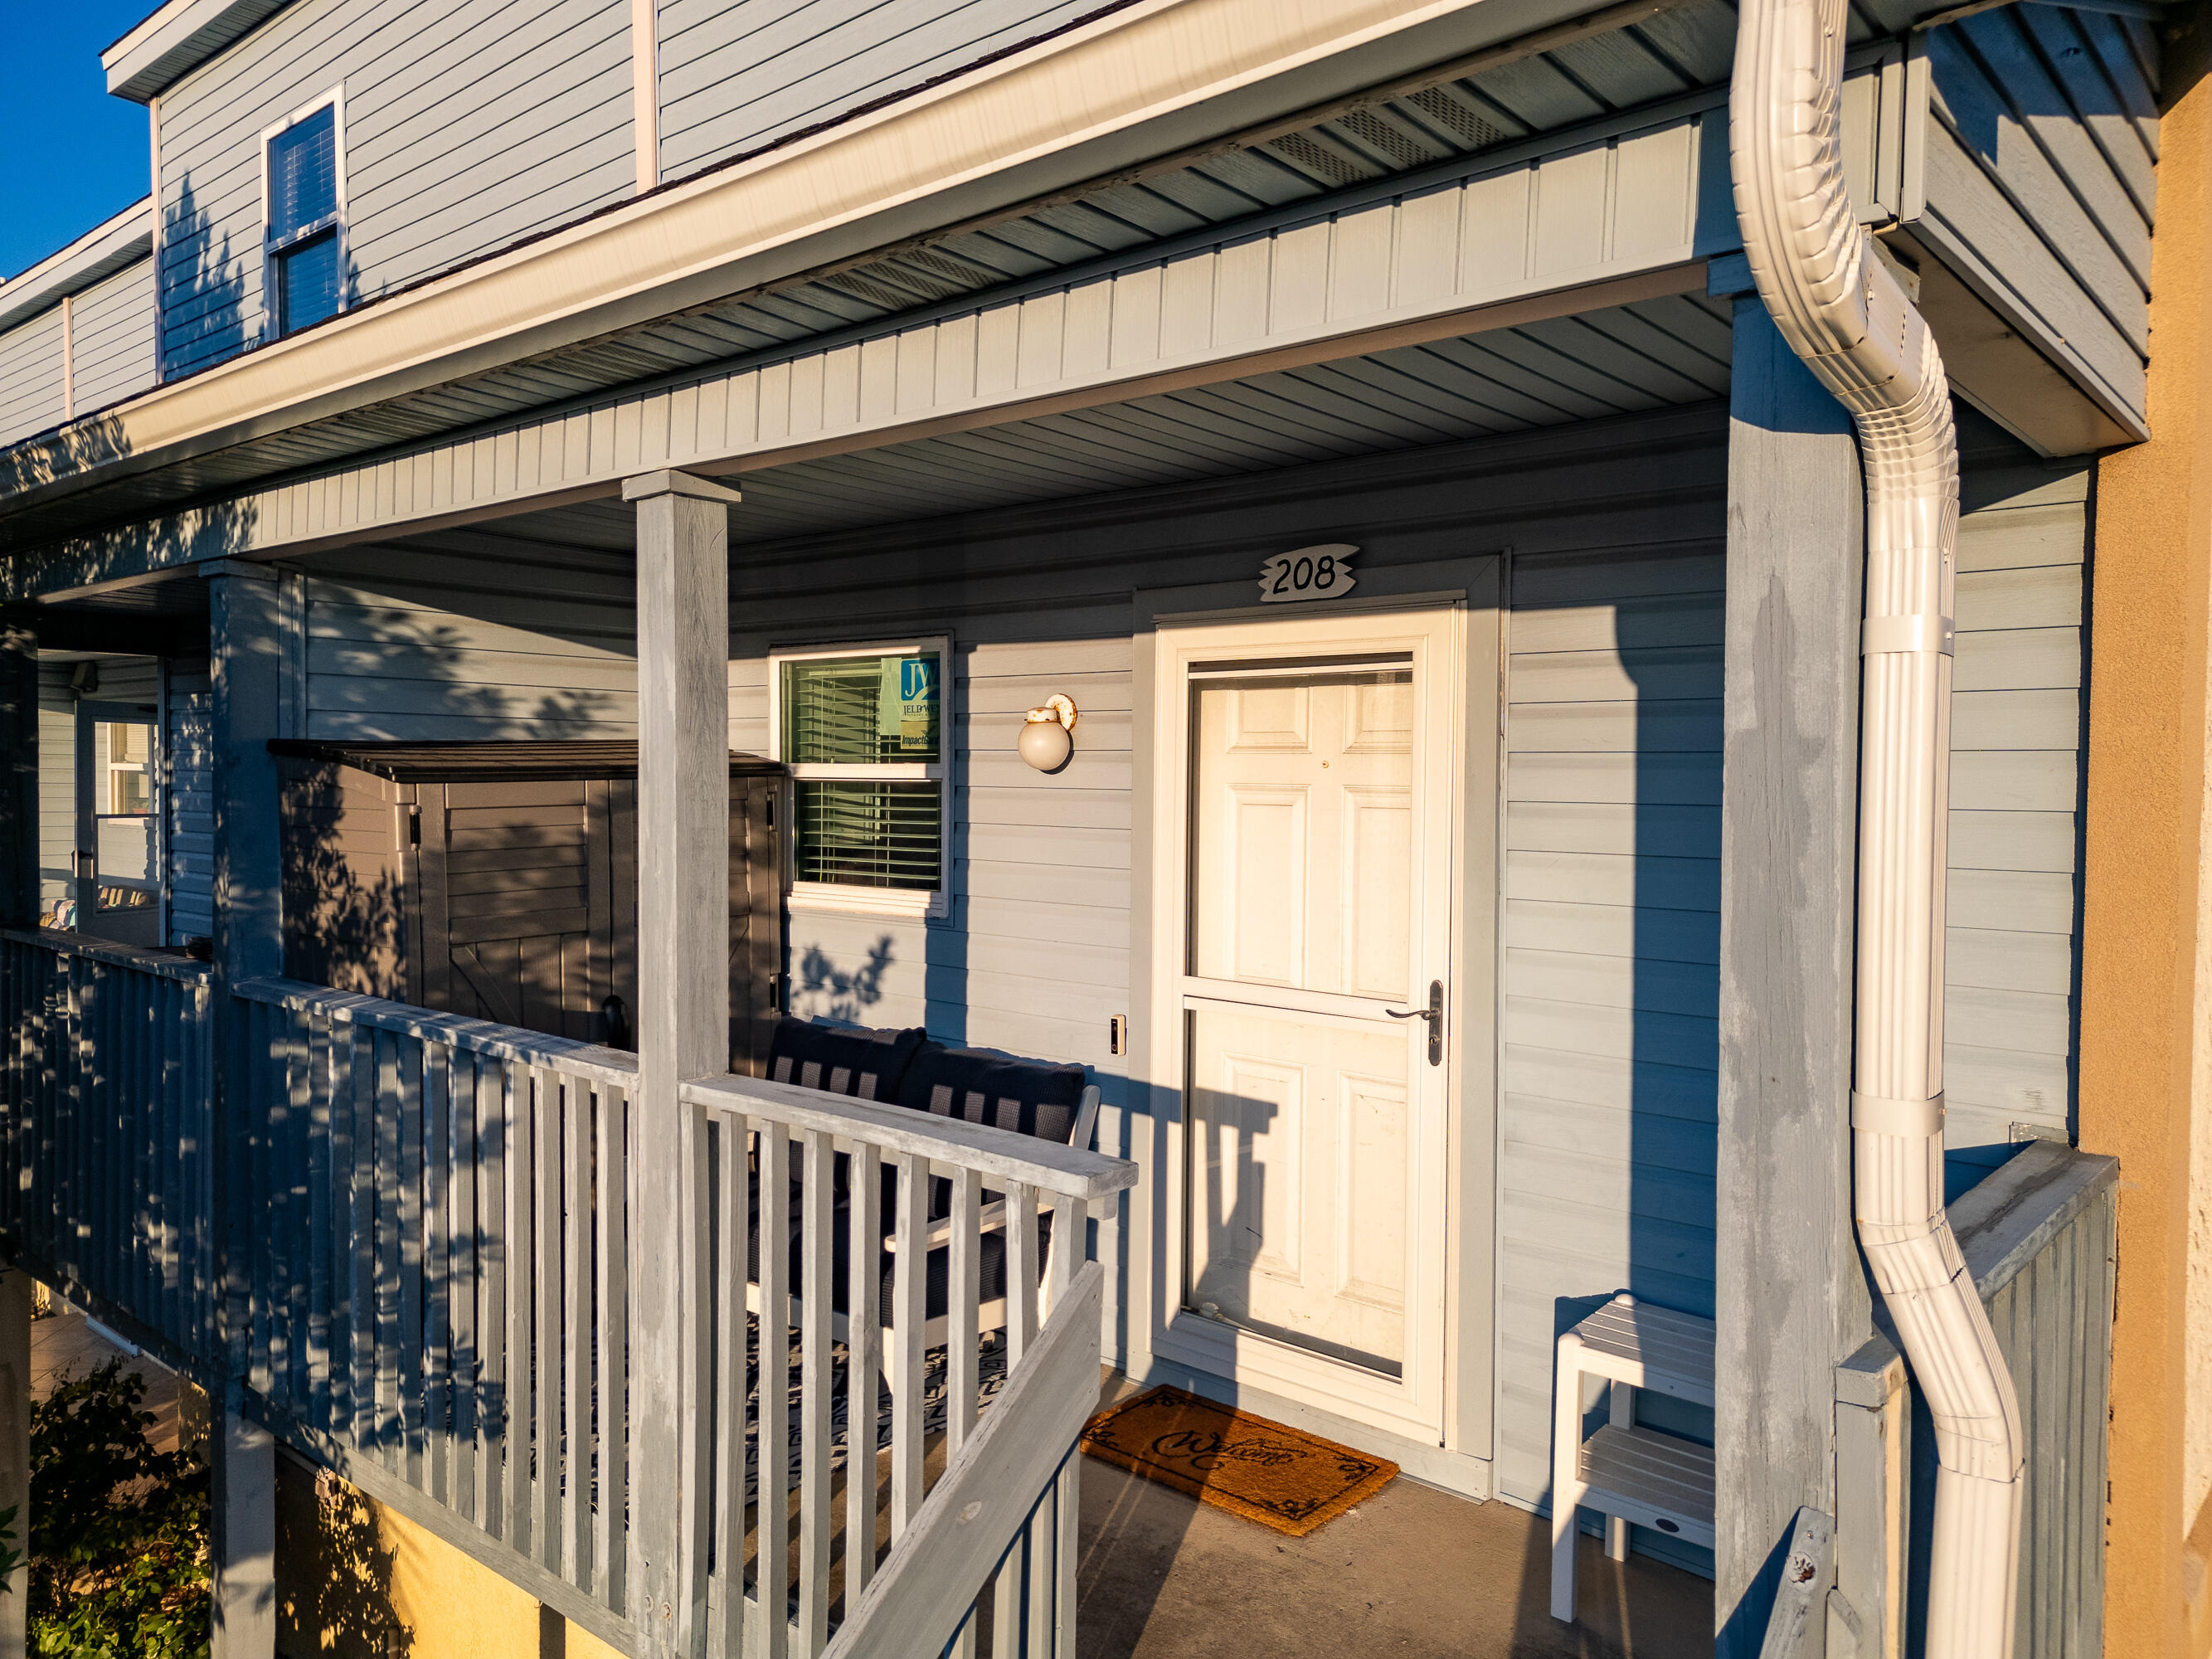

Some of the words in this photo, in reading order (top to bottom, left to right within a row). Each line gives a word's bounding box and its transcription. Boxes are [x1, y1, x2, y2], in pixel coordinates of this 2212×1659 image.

[1273, 555, 1336, 595] 208
[903, 703, 939, 716] JELD-WE
[1152, 1429, 1307, 1470] Welcome
